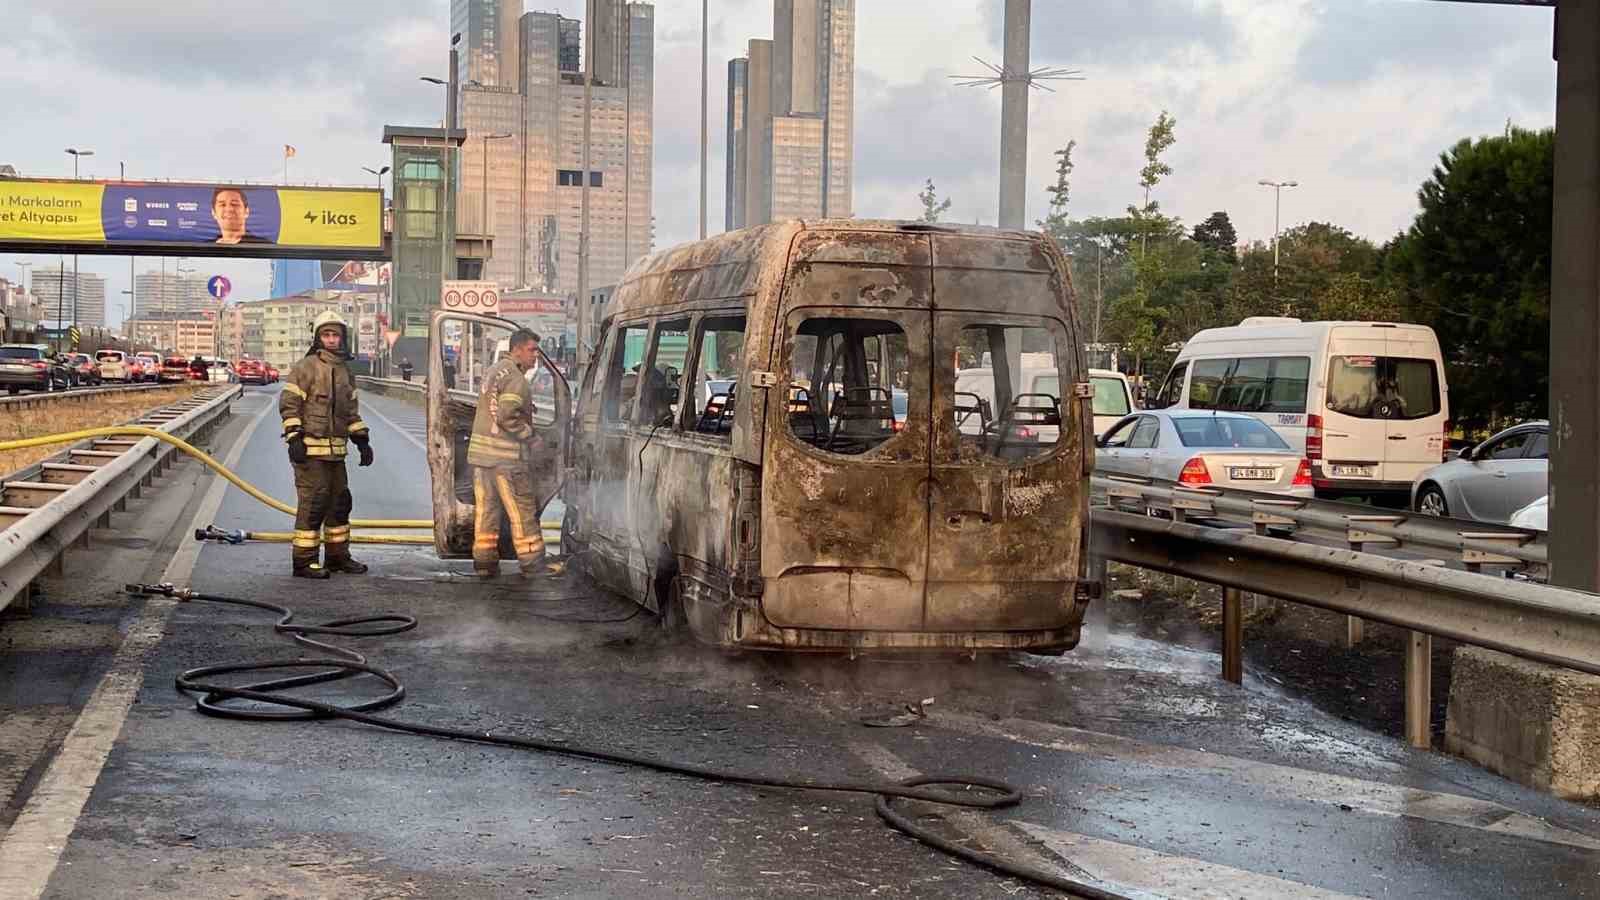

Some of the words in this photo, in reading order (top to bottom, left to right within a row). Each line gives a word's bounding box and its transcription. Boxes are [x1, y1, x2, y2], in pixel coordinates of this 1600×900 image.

[9, 196, 82, 208] Markaların
[19, 211, 77, 224] Altyapısı
[322, 210, 357, 225] ikas
